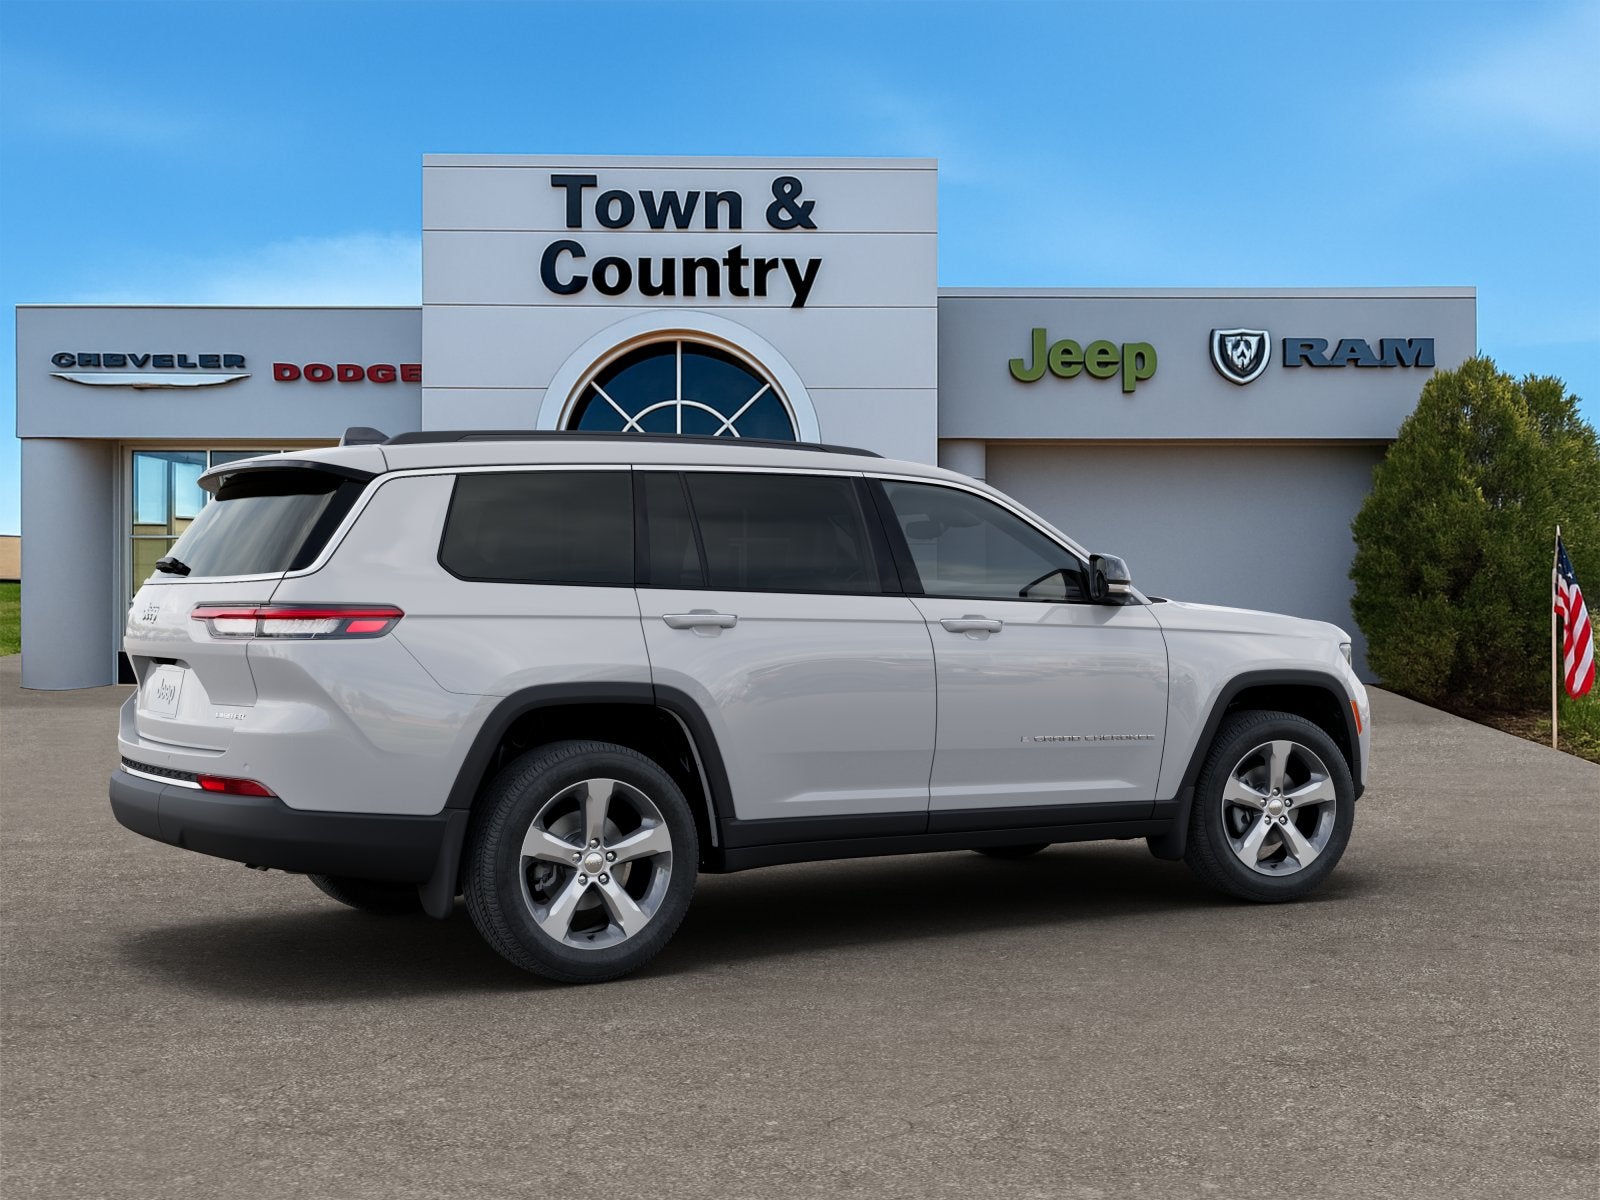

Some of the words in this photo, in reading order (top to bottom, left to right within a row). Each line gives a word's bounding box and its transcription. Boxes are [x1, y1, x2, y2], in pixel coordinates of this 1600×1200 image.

[550, 173, 743, 230] Town
[765, 175, 819, 231] &
[539, 238, 823, 309] Country
[272, 362, 423, 384] DODGE
[1008, 327, 1158, 393] Jeep
[1281, 336, 1436, 368] RAM
